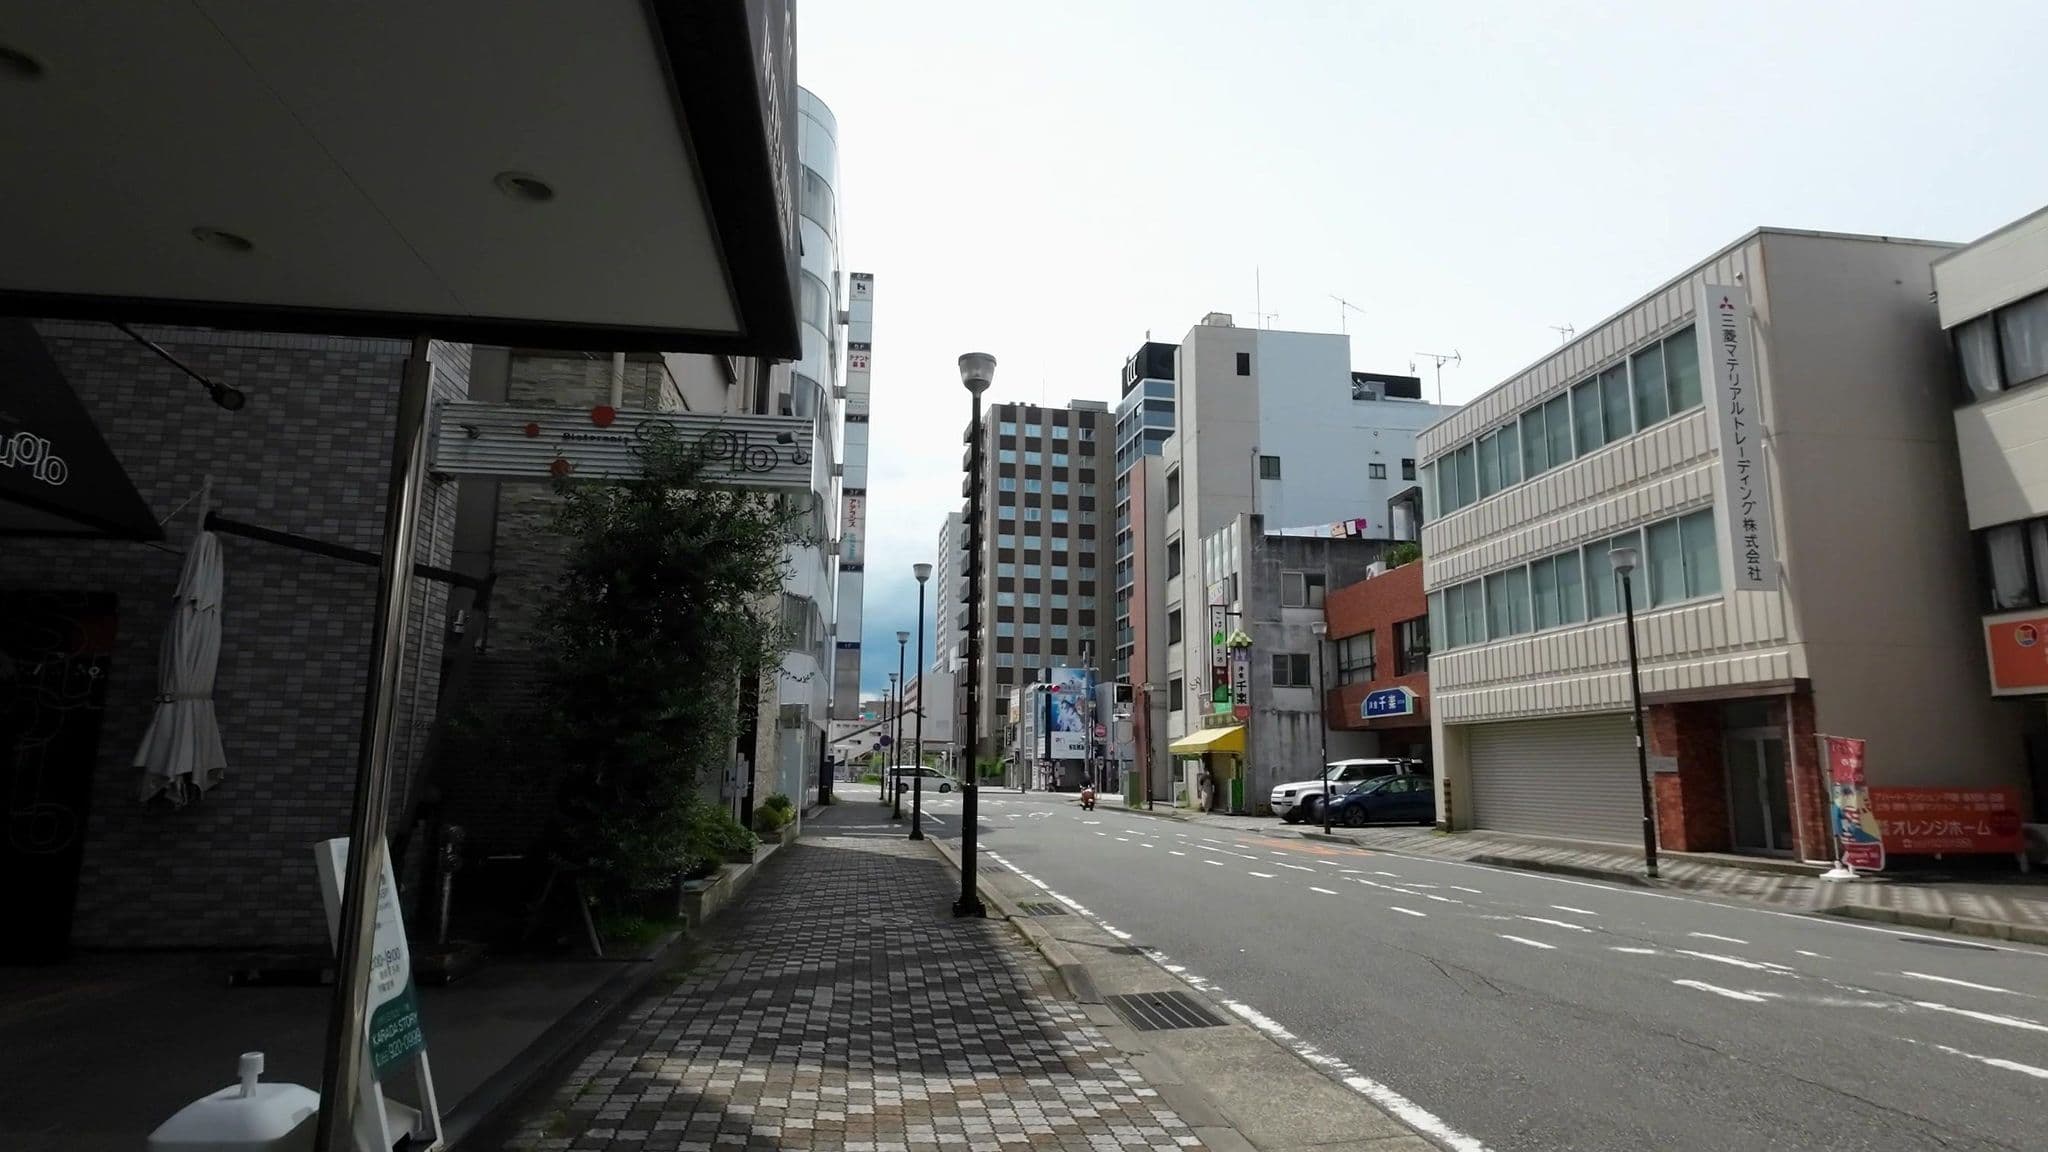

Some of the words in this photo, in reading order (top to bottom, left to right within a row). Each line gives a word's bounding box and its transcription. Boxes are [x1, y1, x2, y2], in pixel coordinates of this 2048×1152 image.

[1720, 313, 1762, 582] 三菱マテリアルトレーディング株式会社
[1891, 819, 1992, 836] オレンジホーム
